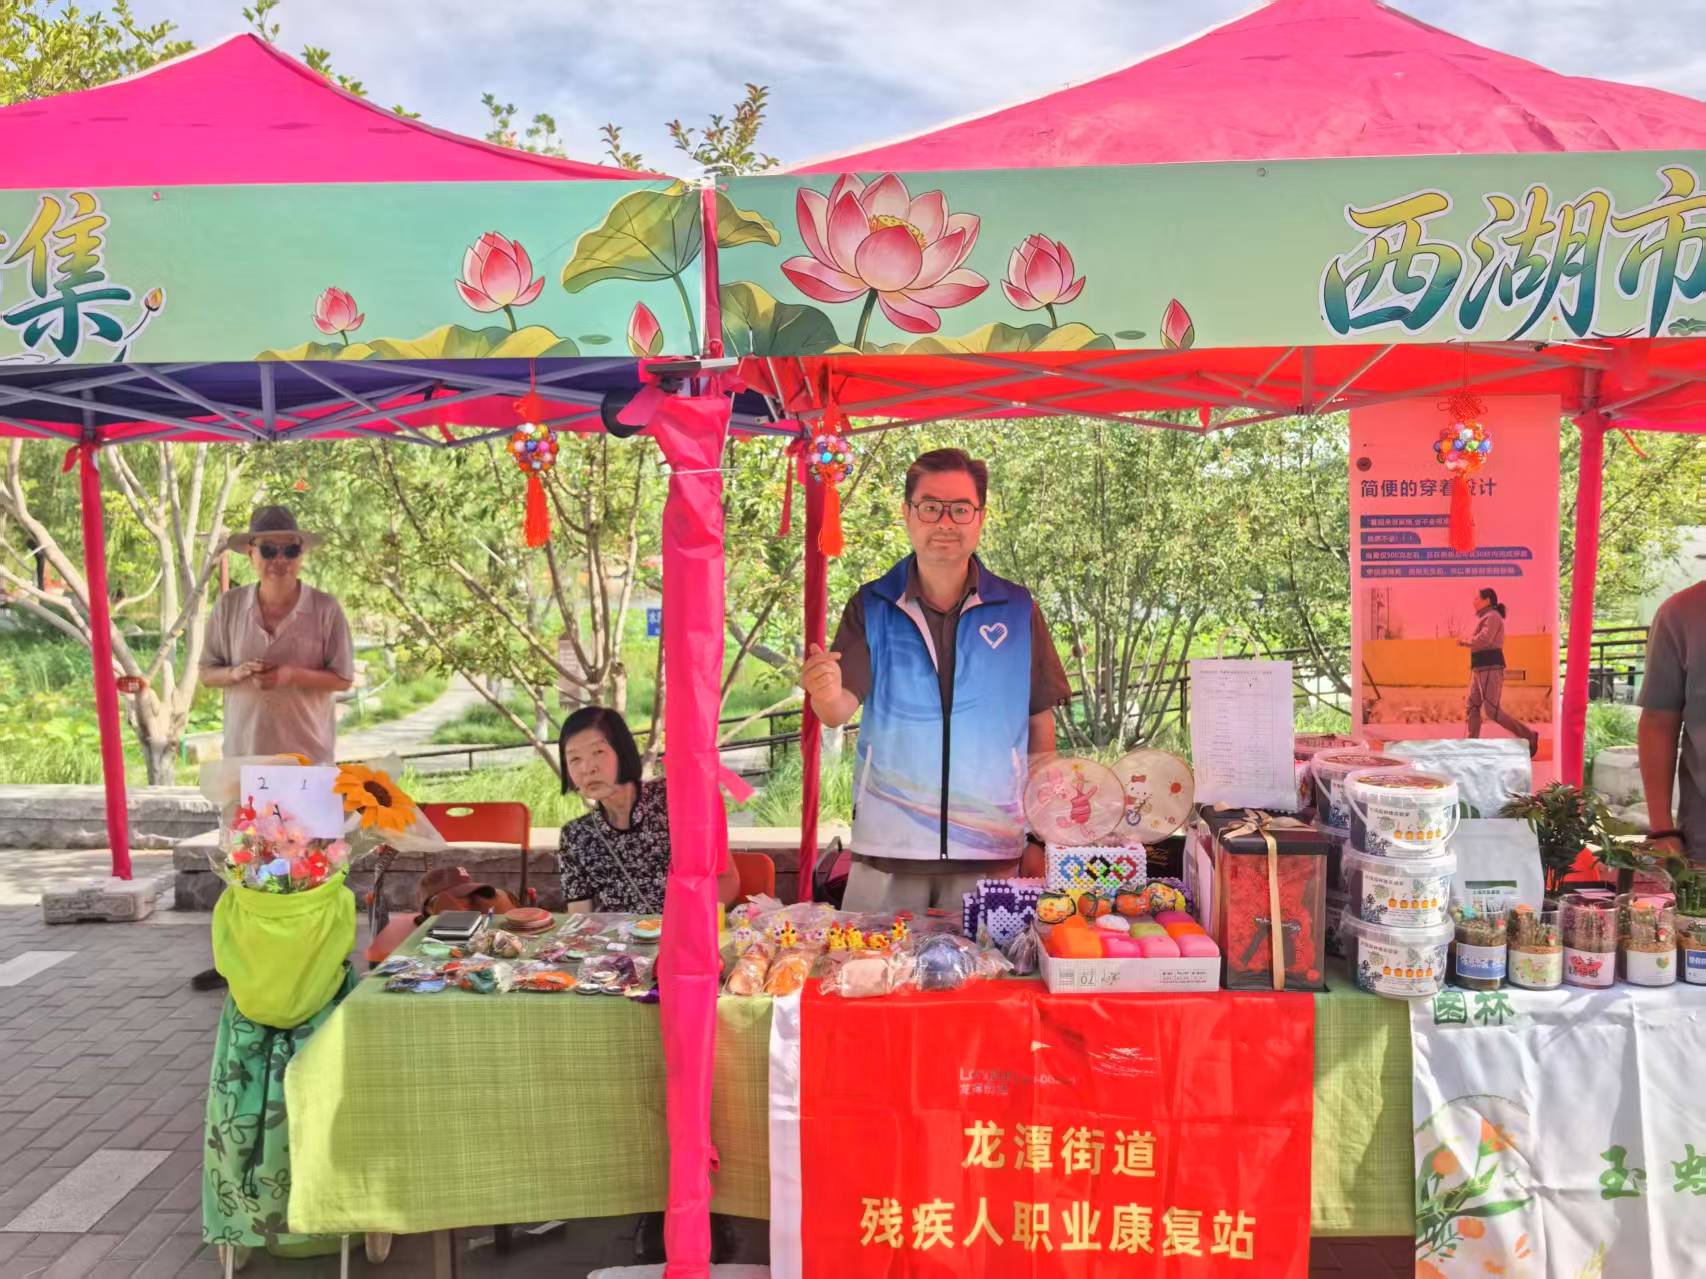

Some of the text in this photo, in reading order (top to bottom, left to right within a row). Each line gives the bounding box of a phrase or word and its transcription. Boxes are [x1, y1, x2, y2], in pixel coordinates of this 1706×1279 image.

[1324, 167, 1706, 341] 西湖市
[961, 1119, 1157, 1178] 龙潭街道
[859, 1196, 1257, 1260] 残疾人职业康复站
